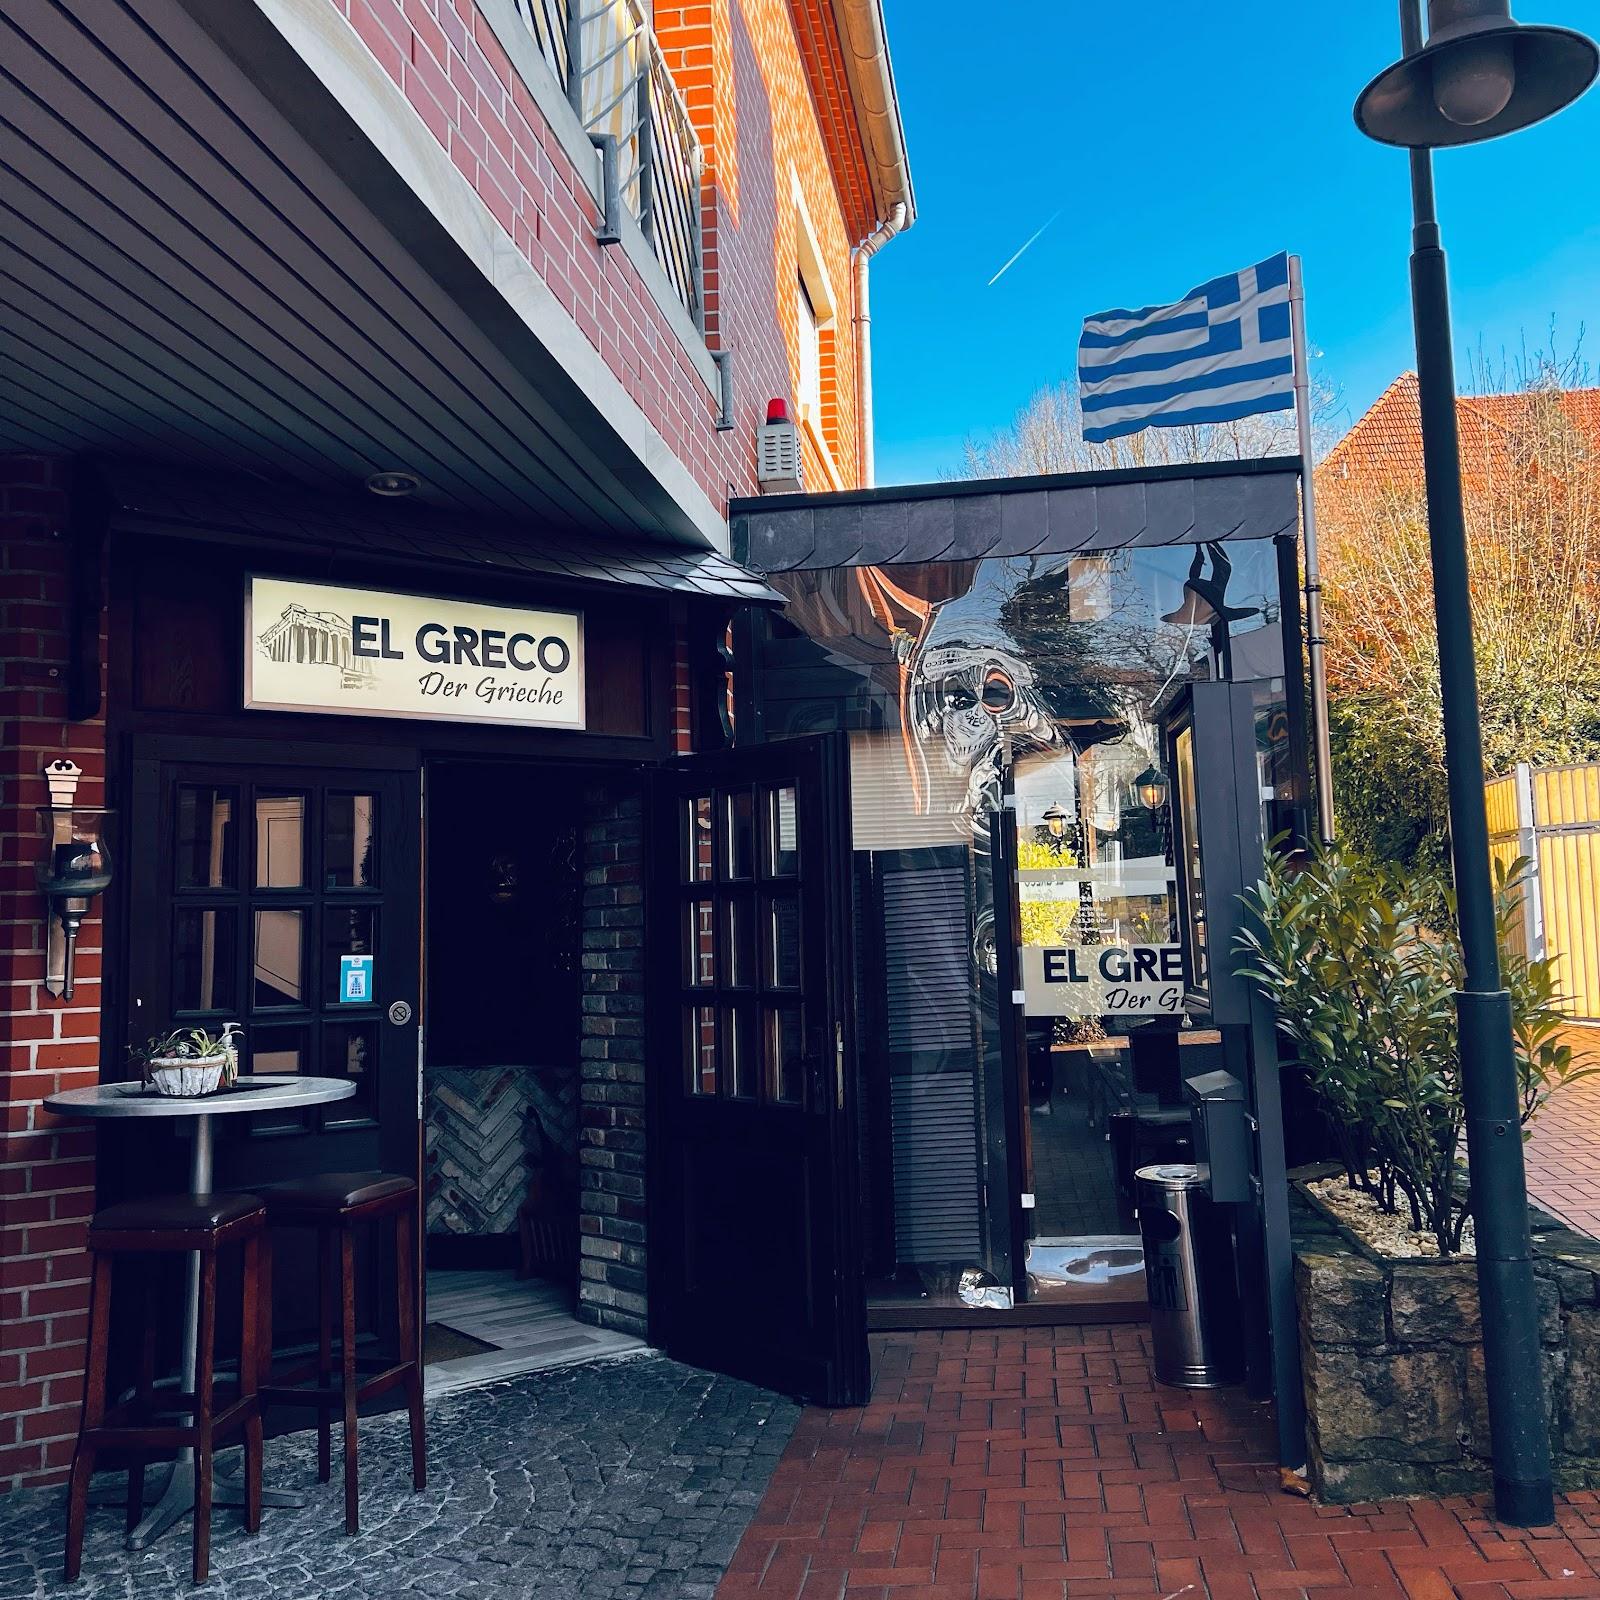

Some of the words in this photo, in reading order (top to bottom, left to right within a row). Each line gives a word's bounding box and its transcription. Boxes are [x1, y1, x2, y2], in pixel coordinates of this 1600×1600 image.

[352, 615, 404, 660] EL
[415, 622, 571, 674] GRECO
[418, 671, 468, 698] Der
[474, 676, 563, 705] Grieche
[1043, 949, 1088, 983] EL
[1105, 988, 1151, 1009] Der
